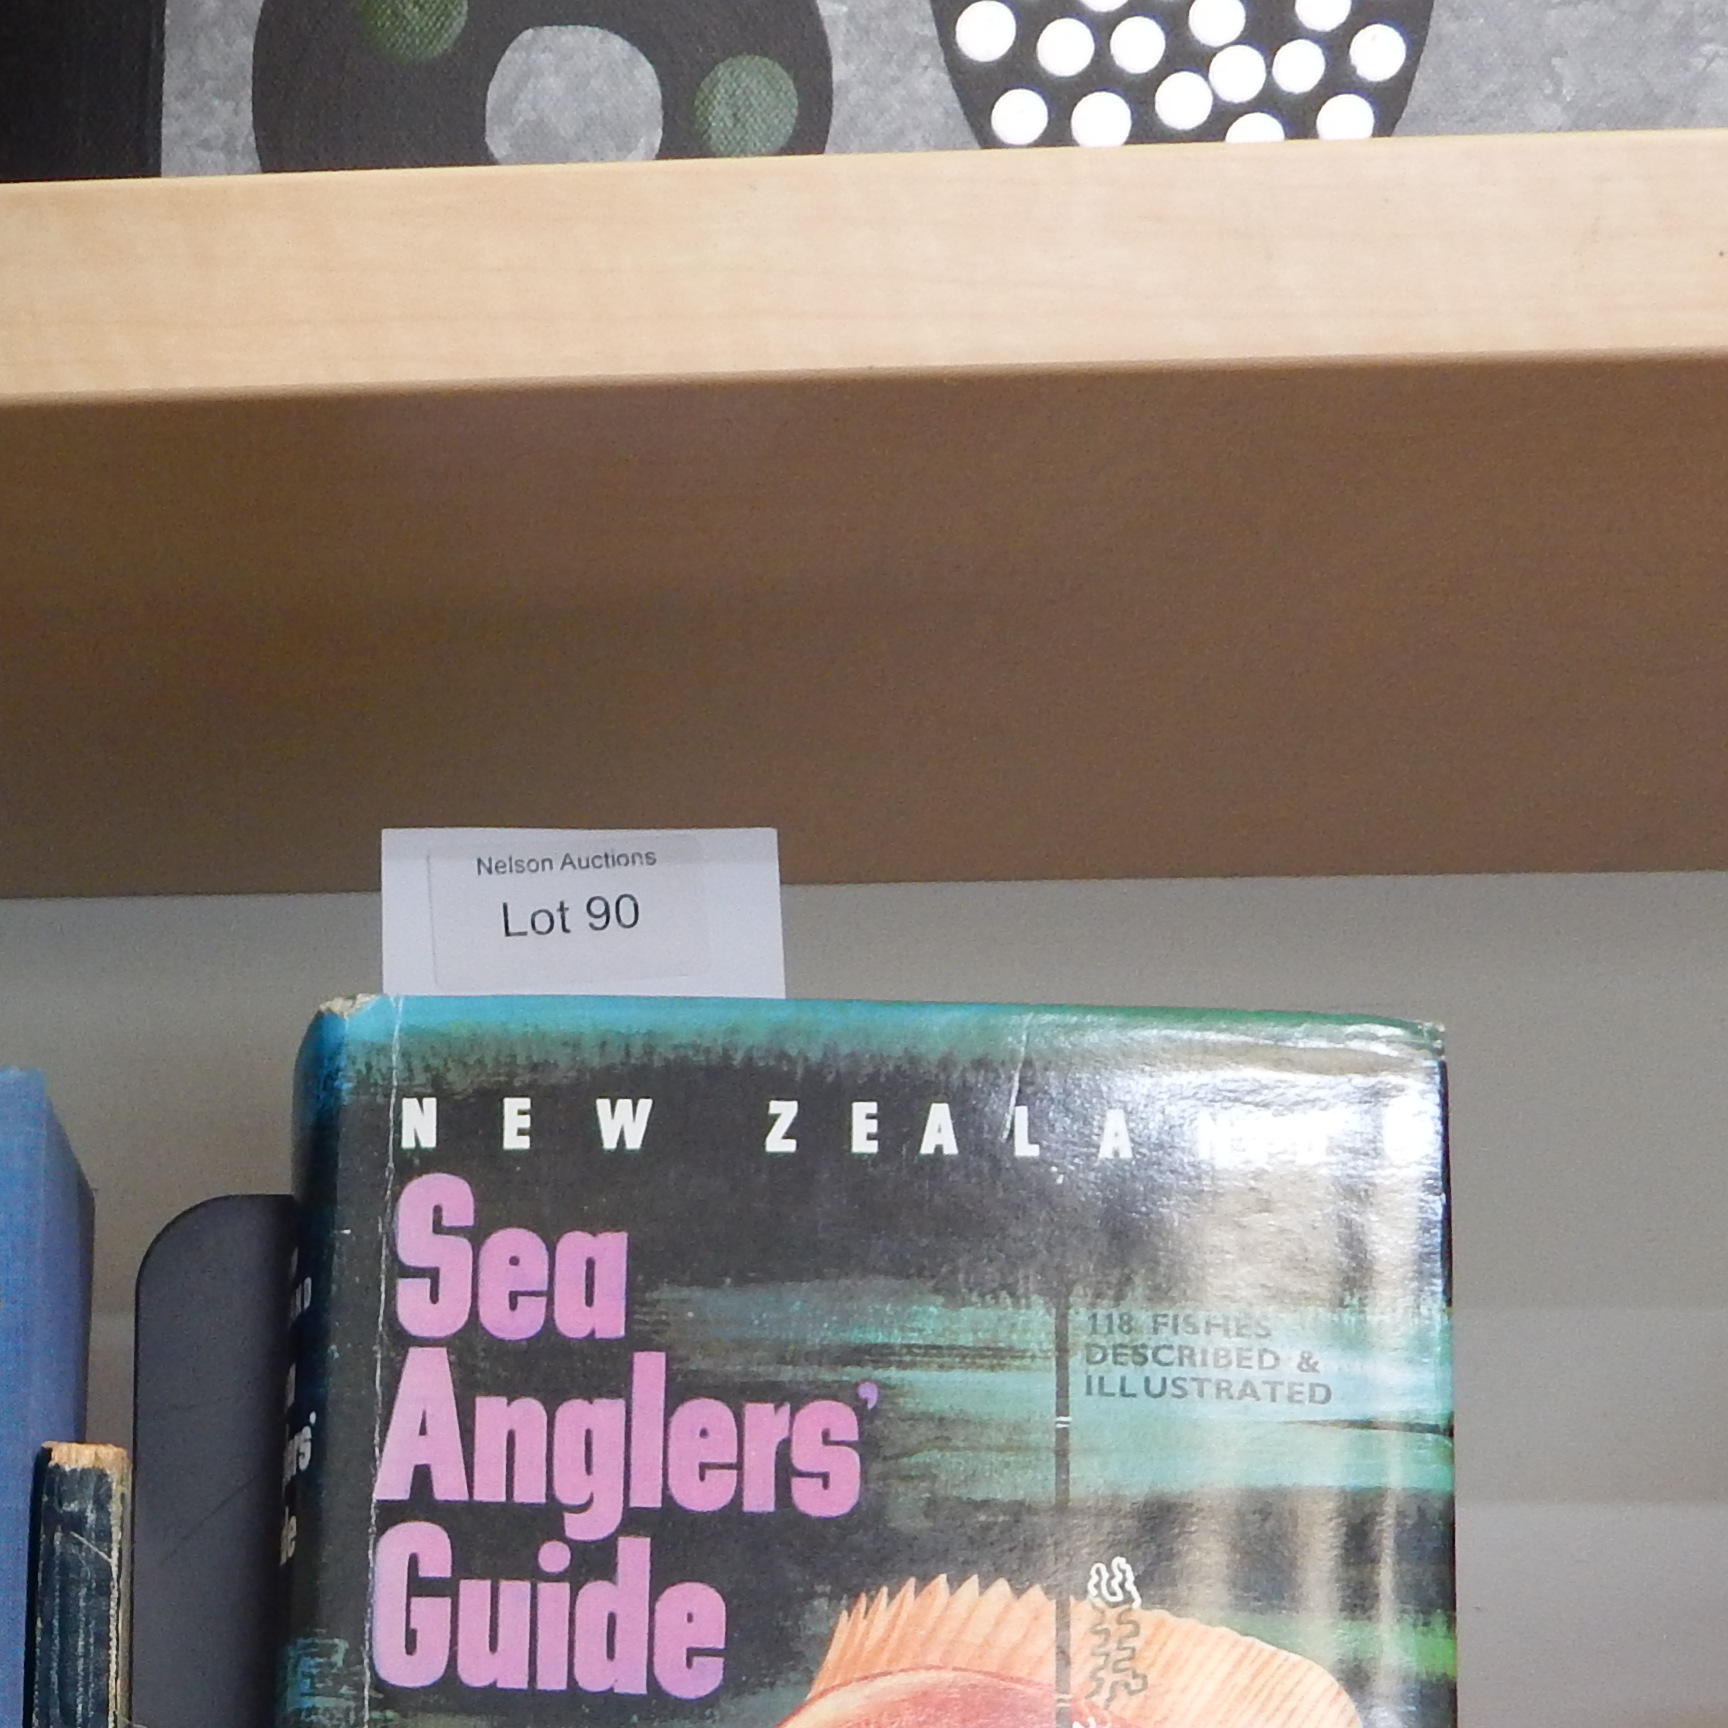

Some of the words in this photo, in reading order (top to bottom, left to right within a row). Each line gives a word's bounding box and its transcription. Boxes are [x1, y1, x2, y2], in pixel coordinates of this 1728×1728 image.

[475, 853, 554, 876] Nelson
[559, 848, 657, 872] Auctions
[501, 897, 571, 937] Lot
[585, 892, 640, 931] 90
[400, 1097, 652, 1150] NEW
[764, 1099, 1325, 1165] ZEALAN
[394, 1173, 629, 1340] Sea
[1085, 1311, 1134, 1336] 118
[1151, 1313, 1273, 1338] FISHES
[1084, 1343, 1281, 1373] DESCRIBED
[1295, 1349, 1321, 1375] &
[1084, 1374, 1333, 1406] ILLUSTRATED
[374, 1346, 879, 1541] Anglers'
[372, 1520, 727, 1700] Guide
